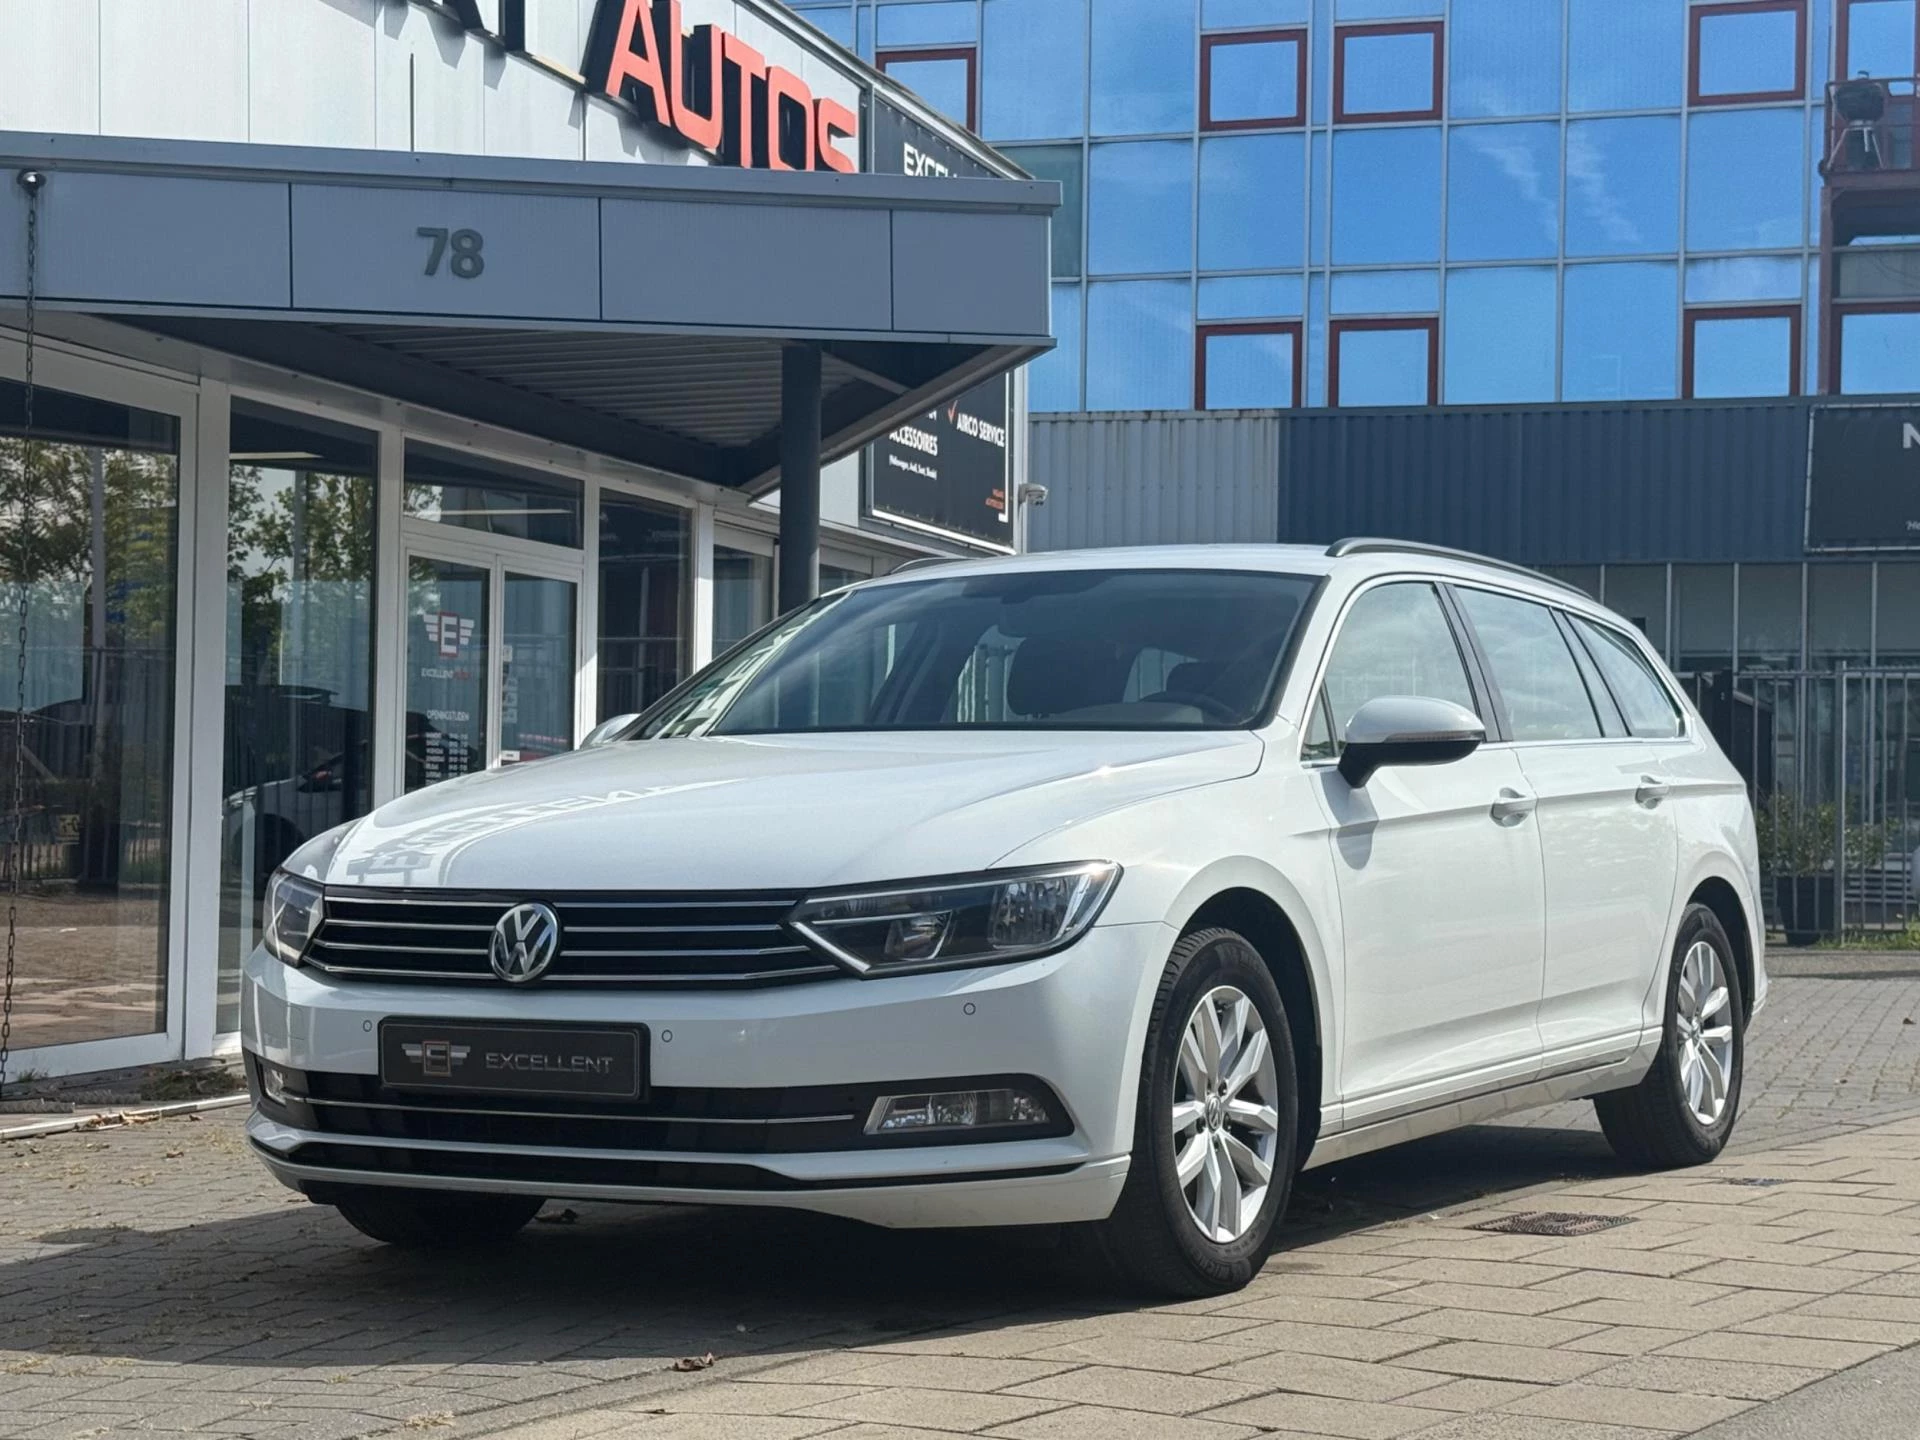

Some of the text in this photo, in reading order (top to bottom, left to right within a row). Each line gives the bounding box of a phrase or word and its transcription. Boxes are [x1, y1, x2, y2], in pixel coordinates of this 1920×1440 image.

[606, 0, 856, 173] AUTOS
[416, 226, 485, 280] 78
[956, 412, 979, 438] AIRCO
[979, 419, 1005, 448] SERVICE
[485, 1052, 613, 1074] EXCELLENT
